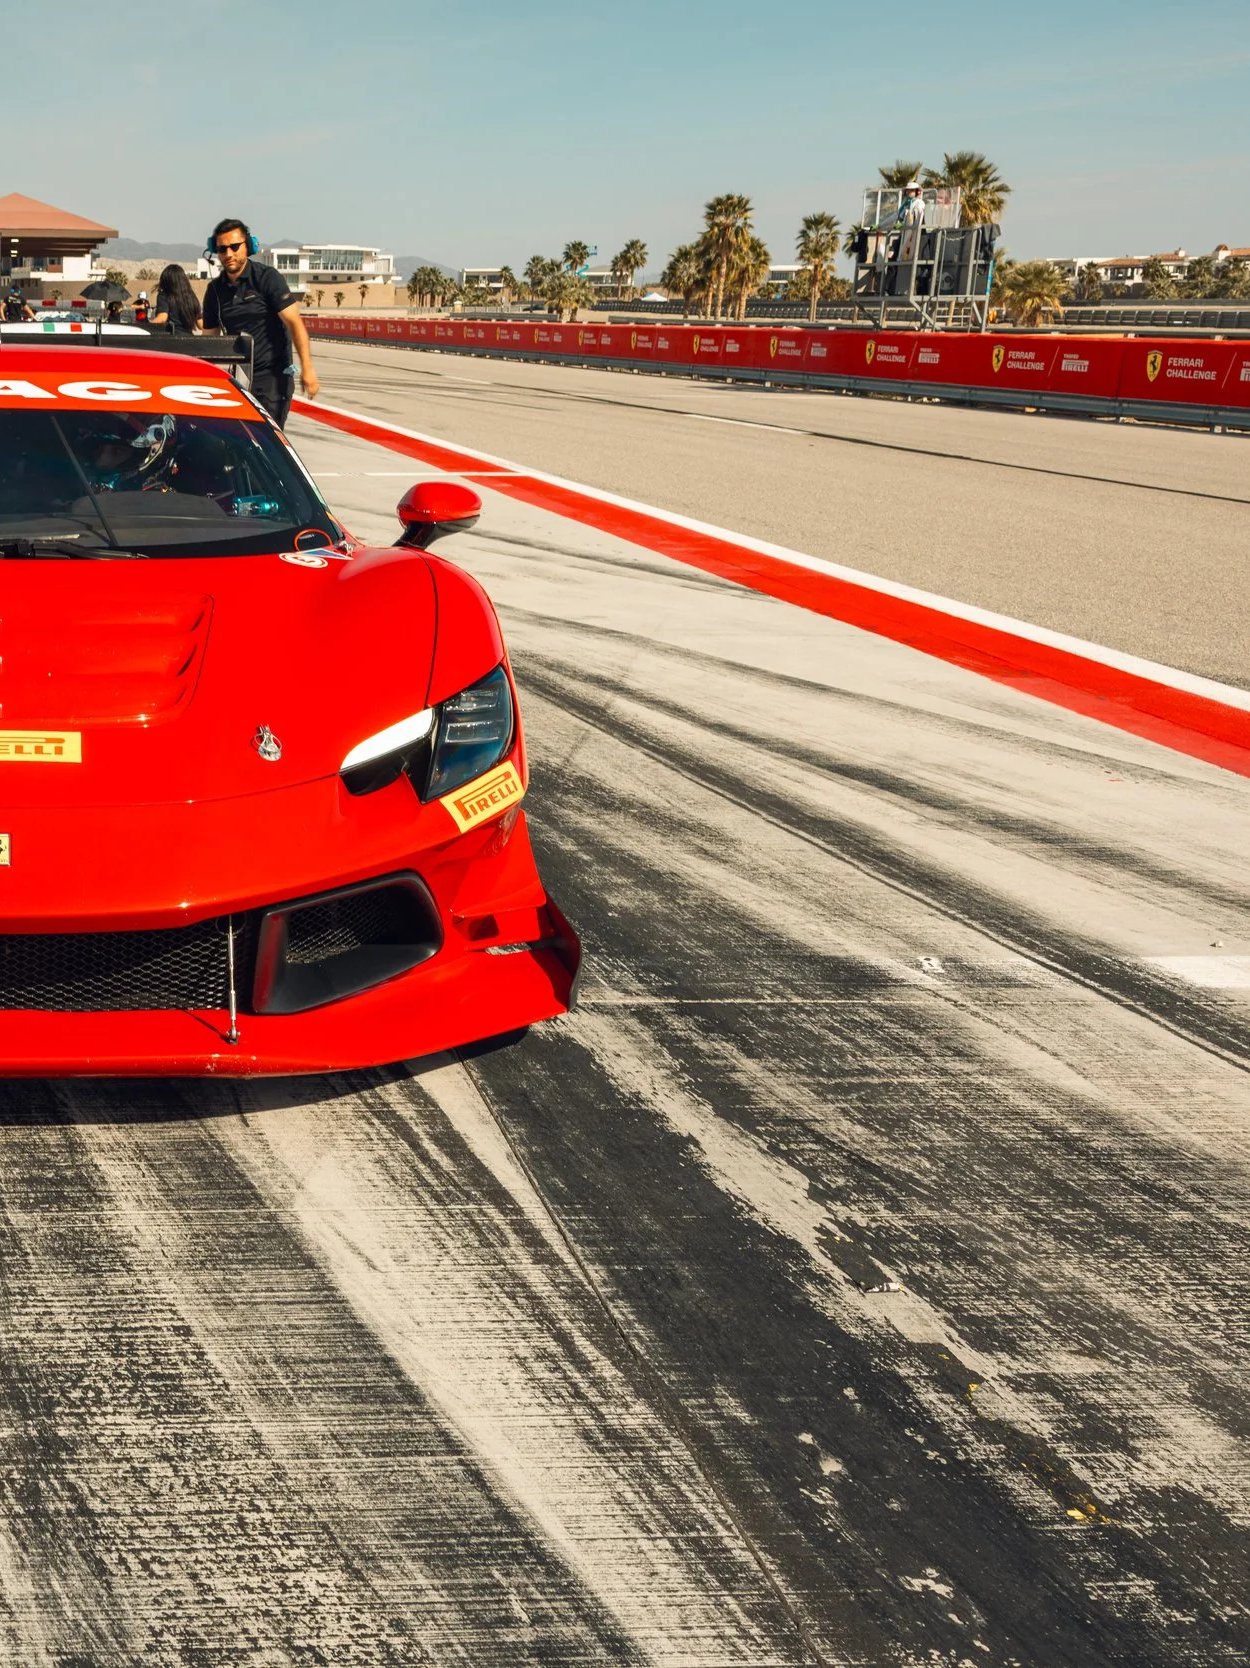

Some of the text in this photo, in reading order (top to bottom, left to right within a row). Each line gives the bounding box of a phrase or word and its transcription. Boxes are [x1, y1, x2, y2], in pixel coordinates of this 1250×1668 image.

[1008, 351, 1035, 360] FERRARI
[1006, 361, 1045, 371] CHALLENGE
[1061, 359, 1089, 373] PIRELLI
[1167, 357, 1204, 368] FERRARI
[1166, 368, 1217, 381] CHALLENGE
[452, 770, 519, 822] PIRELLI
